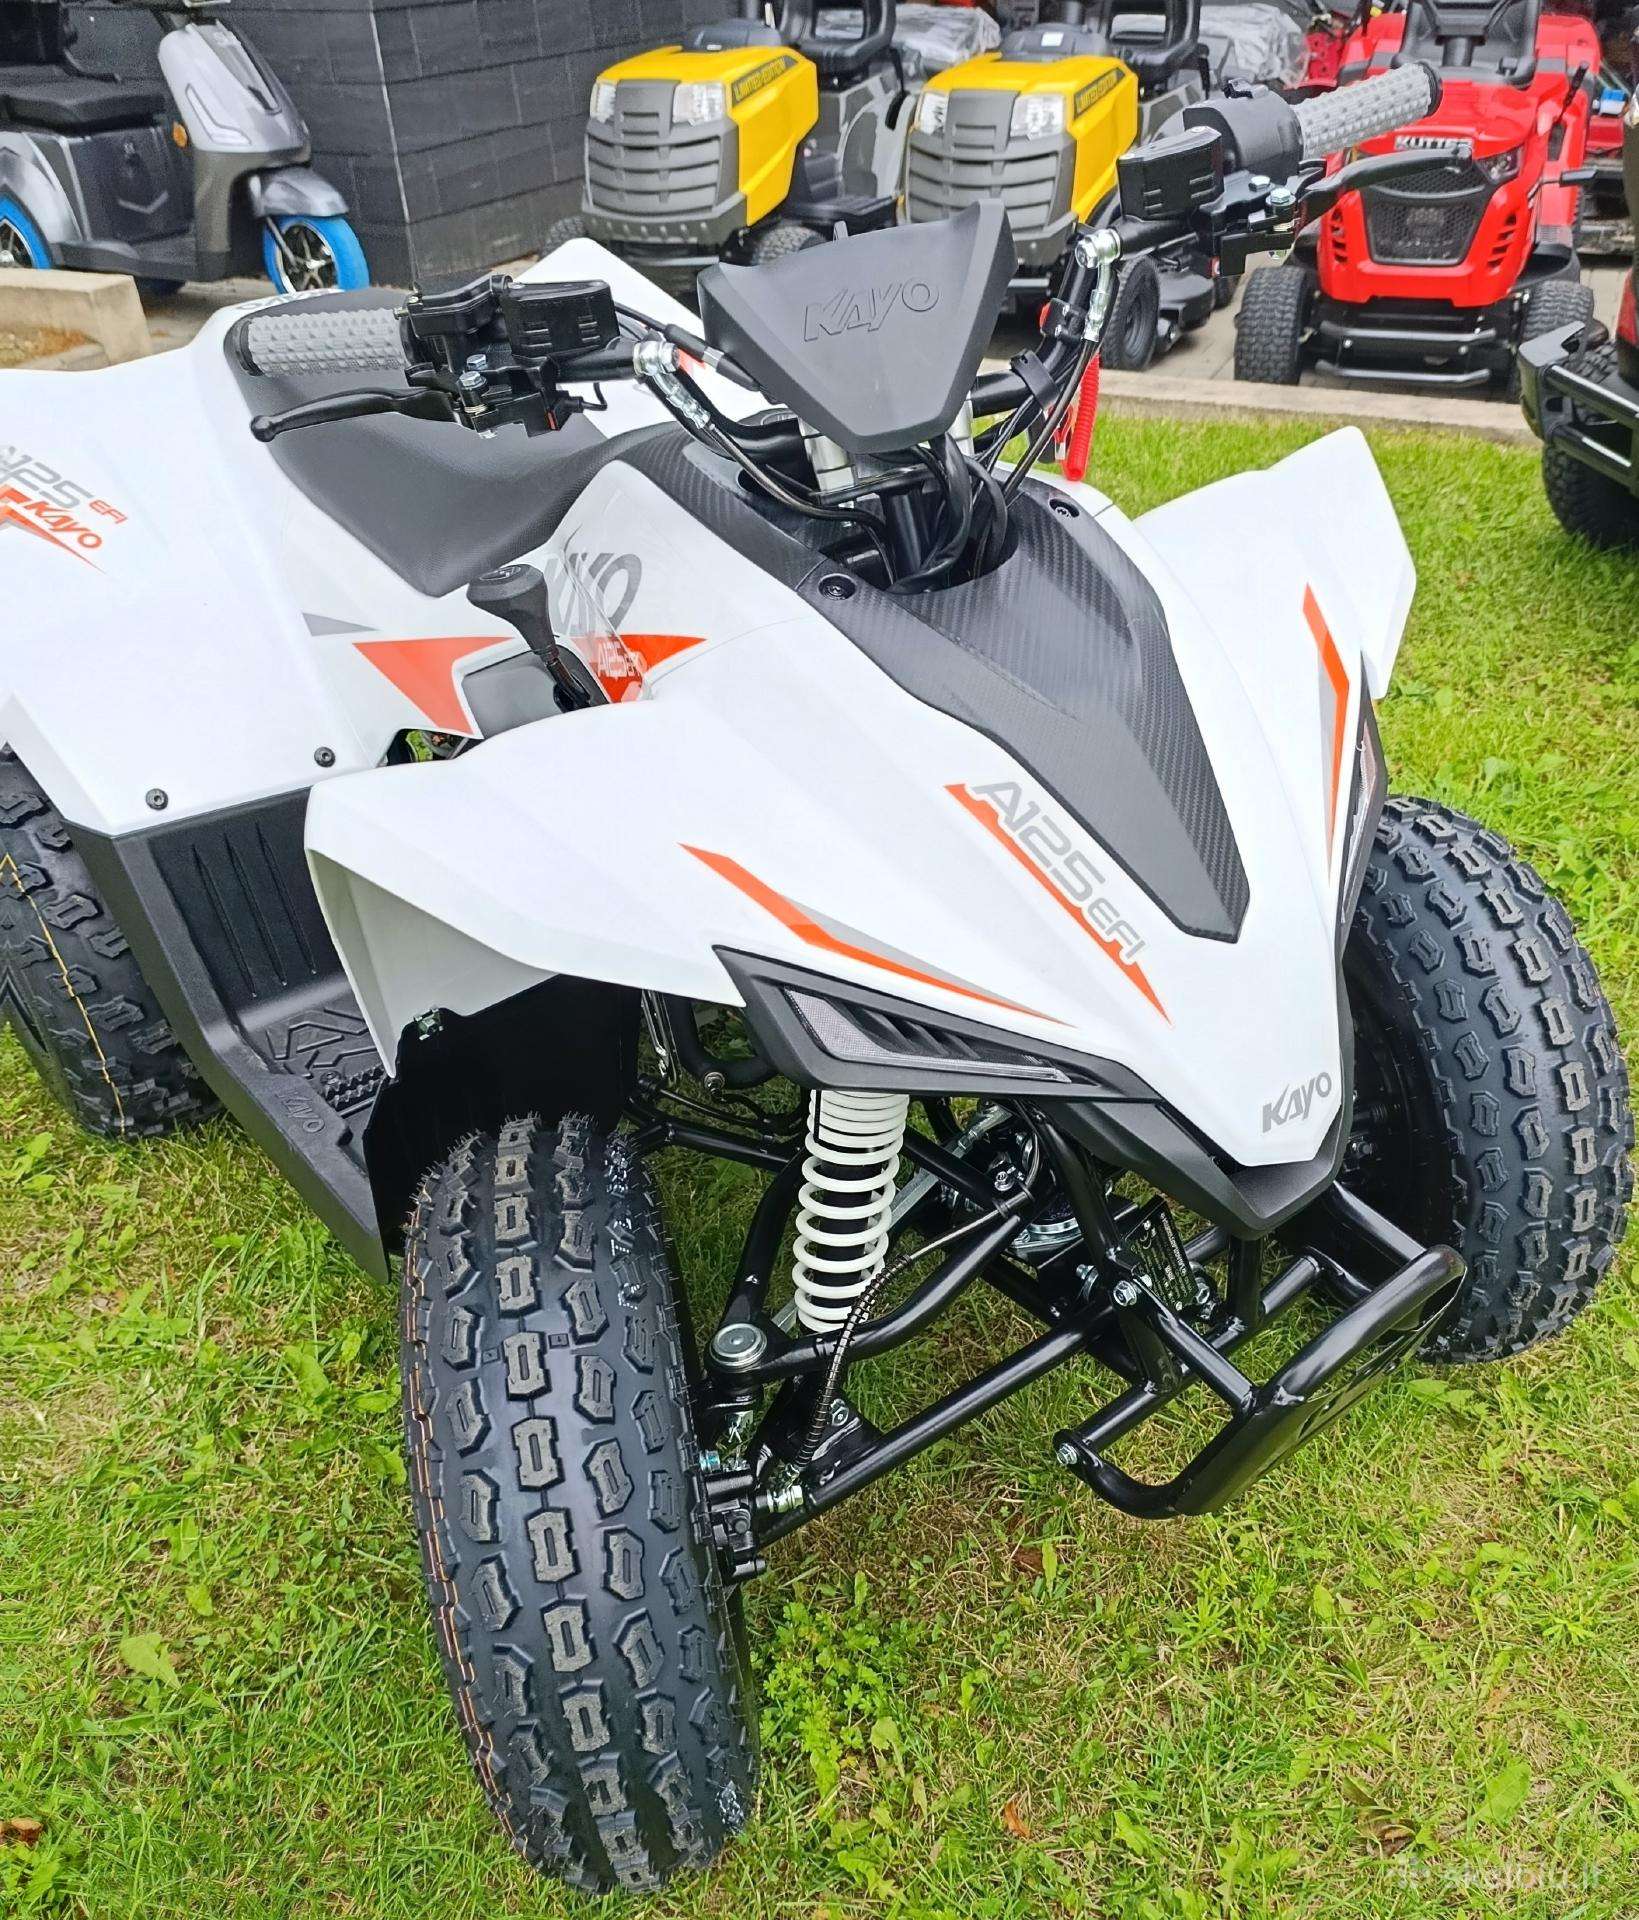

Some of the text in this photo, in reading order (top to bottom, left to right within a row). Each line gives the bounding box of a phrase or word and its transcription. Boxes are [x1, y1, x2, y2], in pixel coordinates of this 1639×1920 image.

[803, 276, 940, 343] KAYO
[23, 501, 102, 549] KAYO
[89, 499, 128, 525] EFI
[972, 781, 1147, 960] A125 EFI
[1262, 1071, 1333, 1134] KAYO
